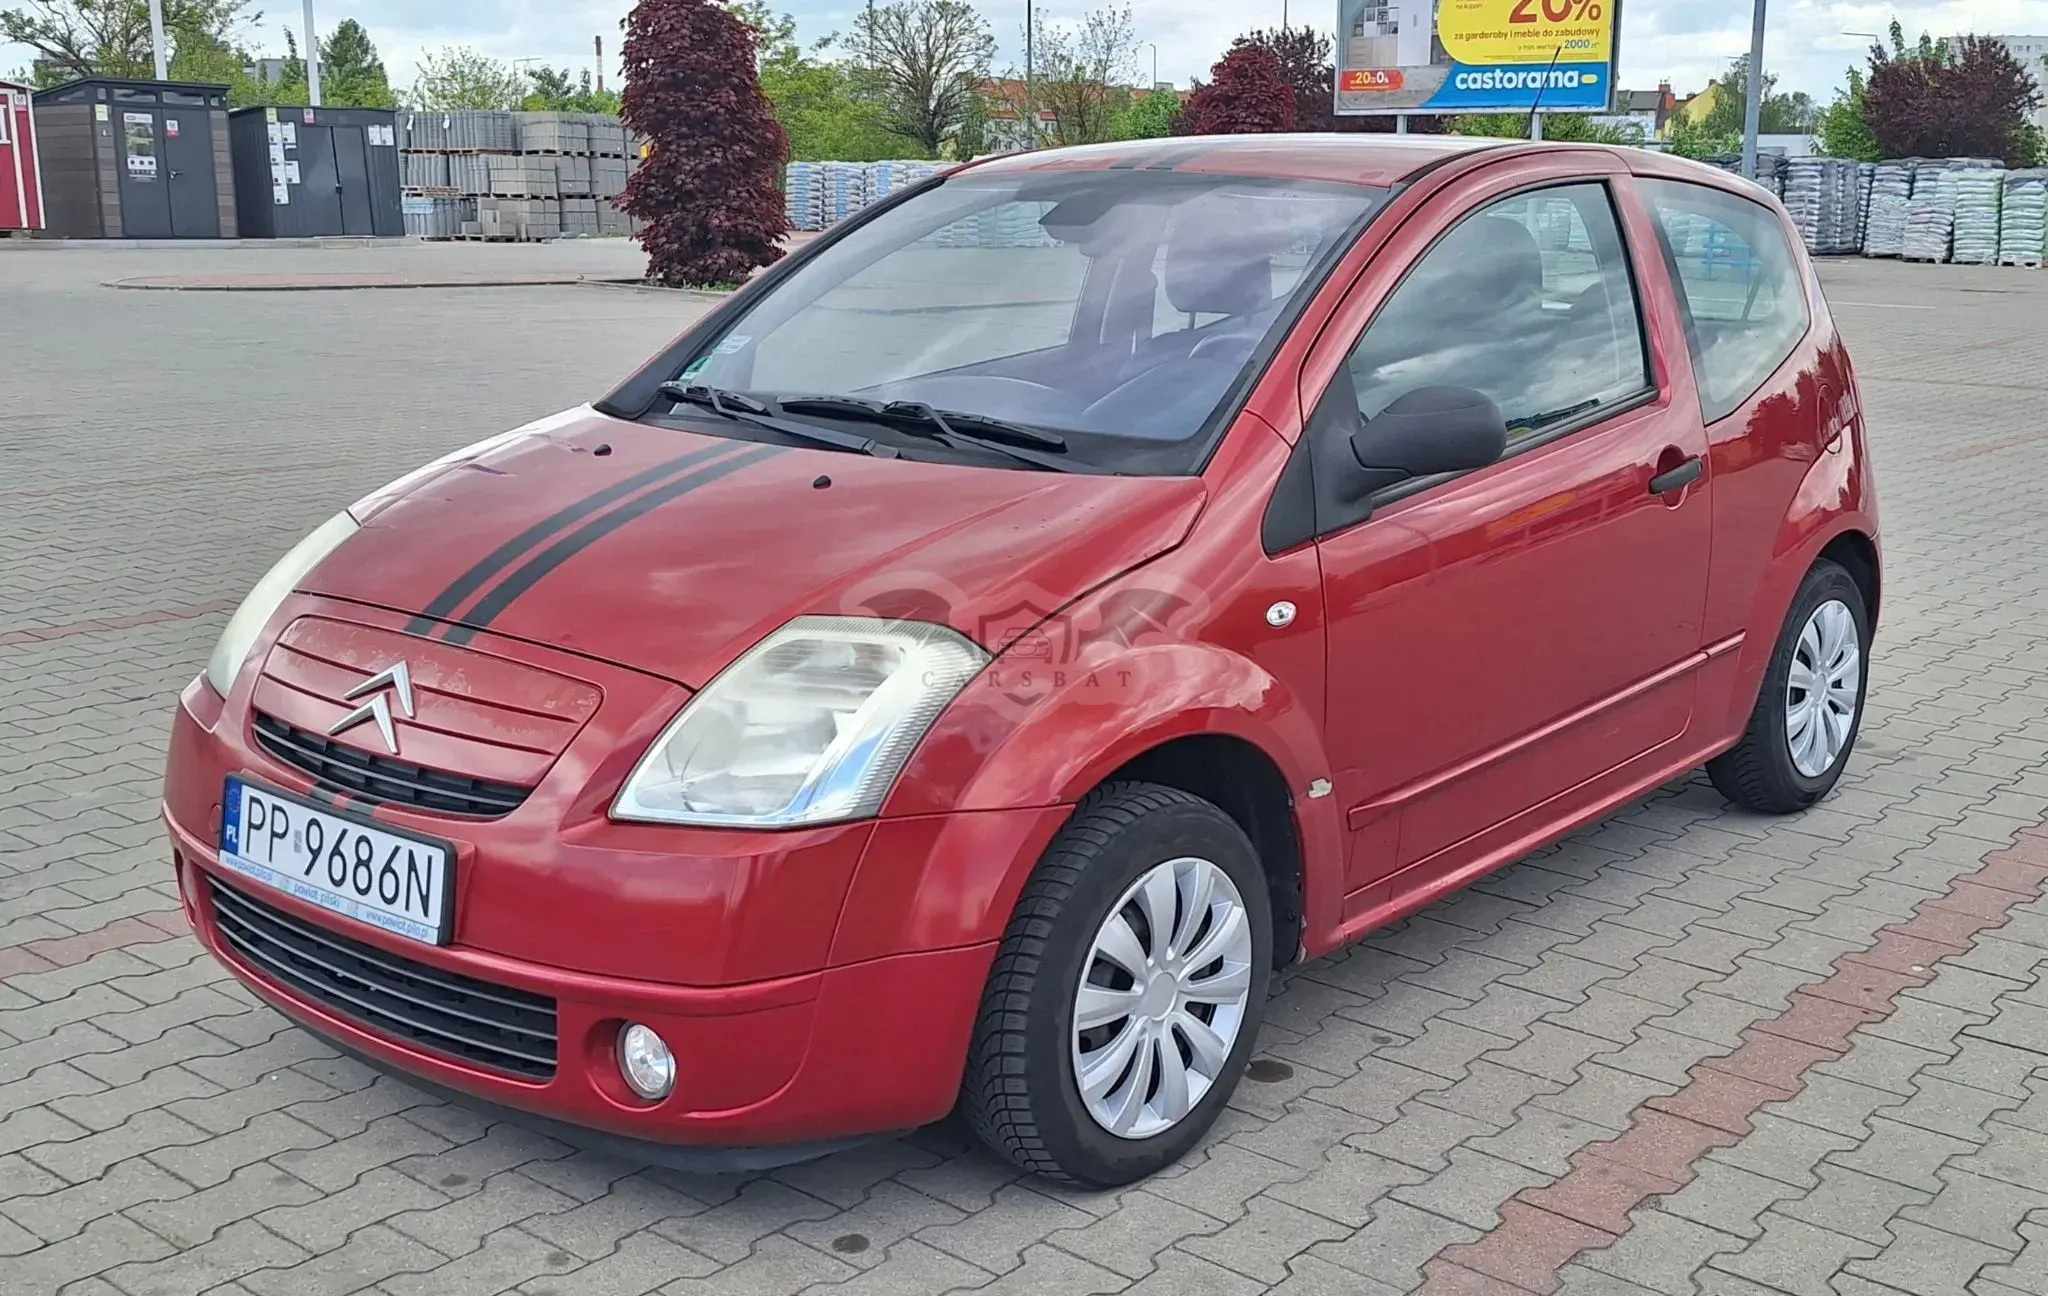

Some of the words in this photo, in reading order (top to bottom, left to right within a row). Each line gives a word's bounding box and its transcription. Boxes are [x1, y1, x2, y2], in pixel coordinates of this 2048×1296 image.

[1509, 0, 1602, 24] 20%
[1465, 30, 1509, 41] garderoby
[1514, 28, 1541, 38] meble
[1542, 28, 1553, 37] do
[1554, 27, 1601, 38] zabudowy
[1564, 39, 1590, 49] 2000
[1355, 71, 1371, 84] 20
[1455, 69, 1579, 89] castorama
[226, 824, 238, 844] PL
[246, 795, 290, 863] PP
[304, 817, 433, 918] 9686N
